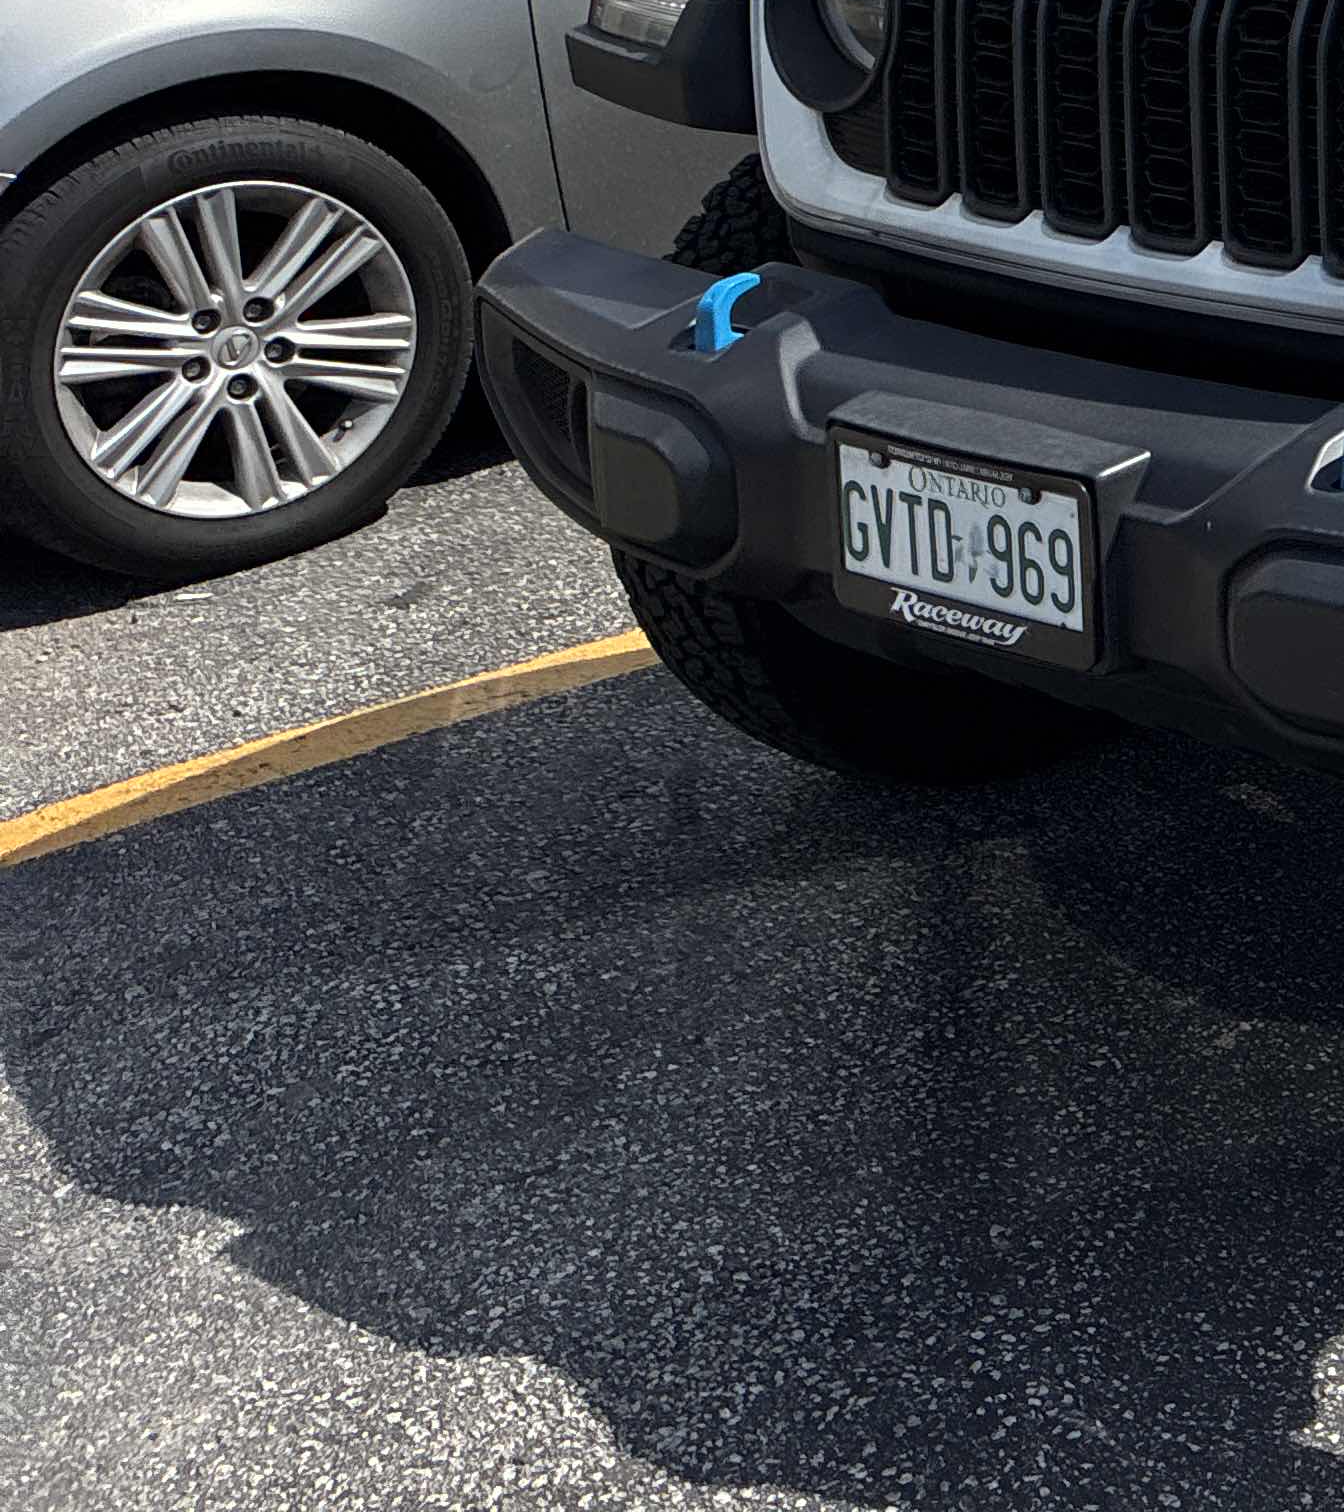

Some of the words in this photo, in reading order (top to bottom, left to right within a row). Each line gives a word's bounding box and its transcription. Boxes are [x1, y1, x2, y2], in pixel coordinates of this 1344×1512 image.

[907, 466, 1007, 509] ONTARIO
[842, 479, 954, 583] GVTD
[986, 513, 1076, 614] 969
[889, 586, 1029, 647] Raceway
